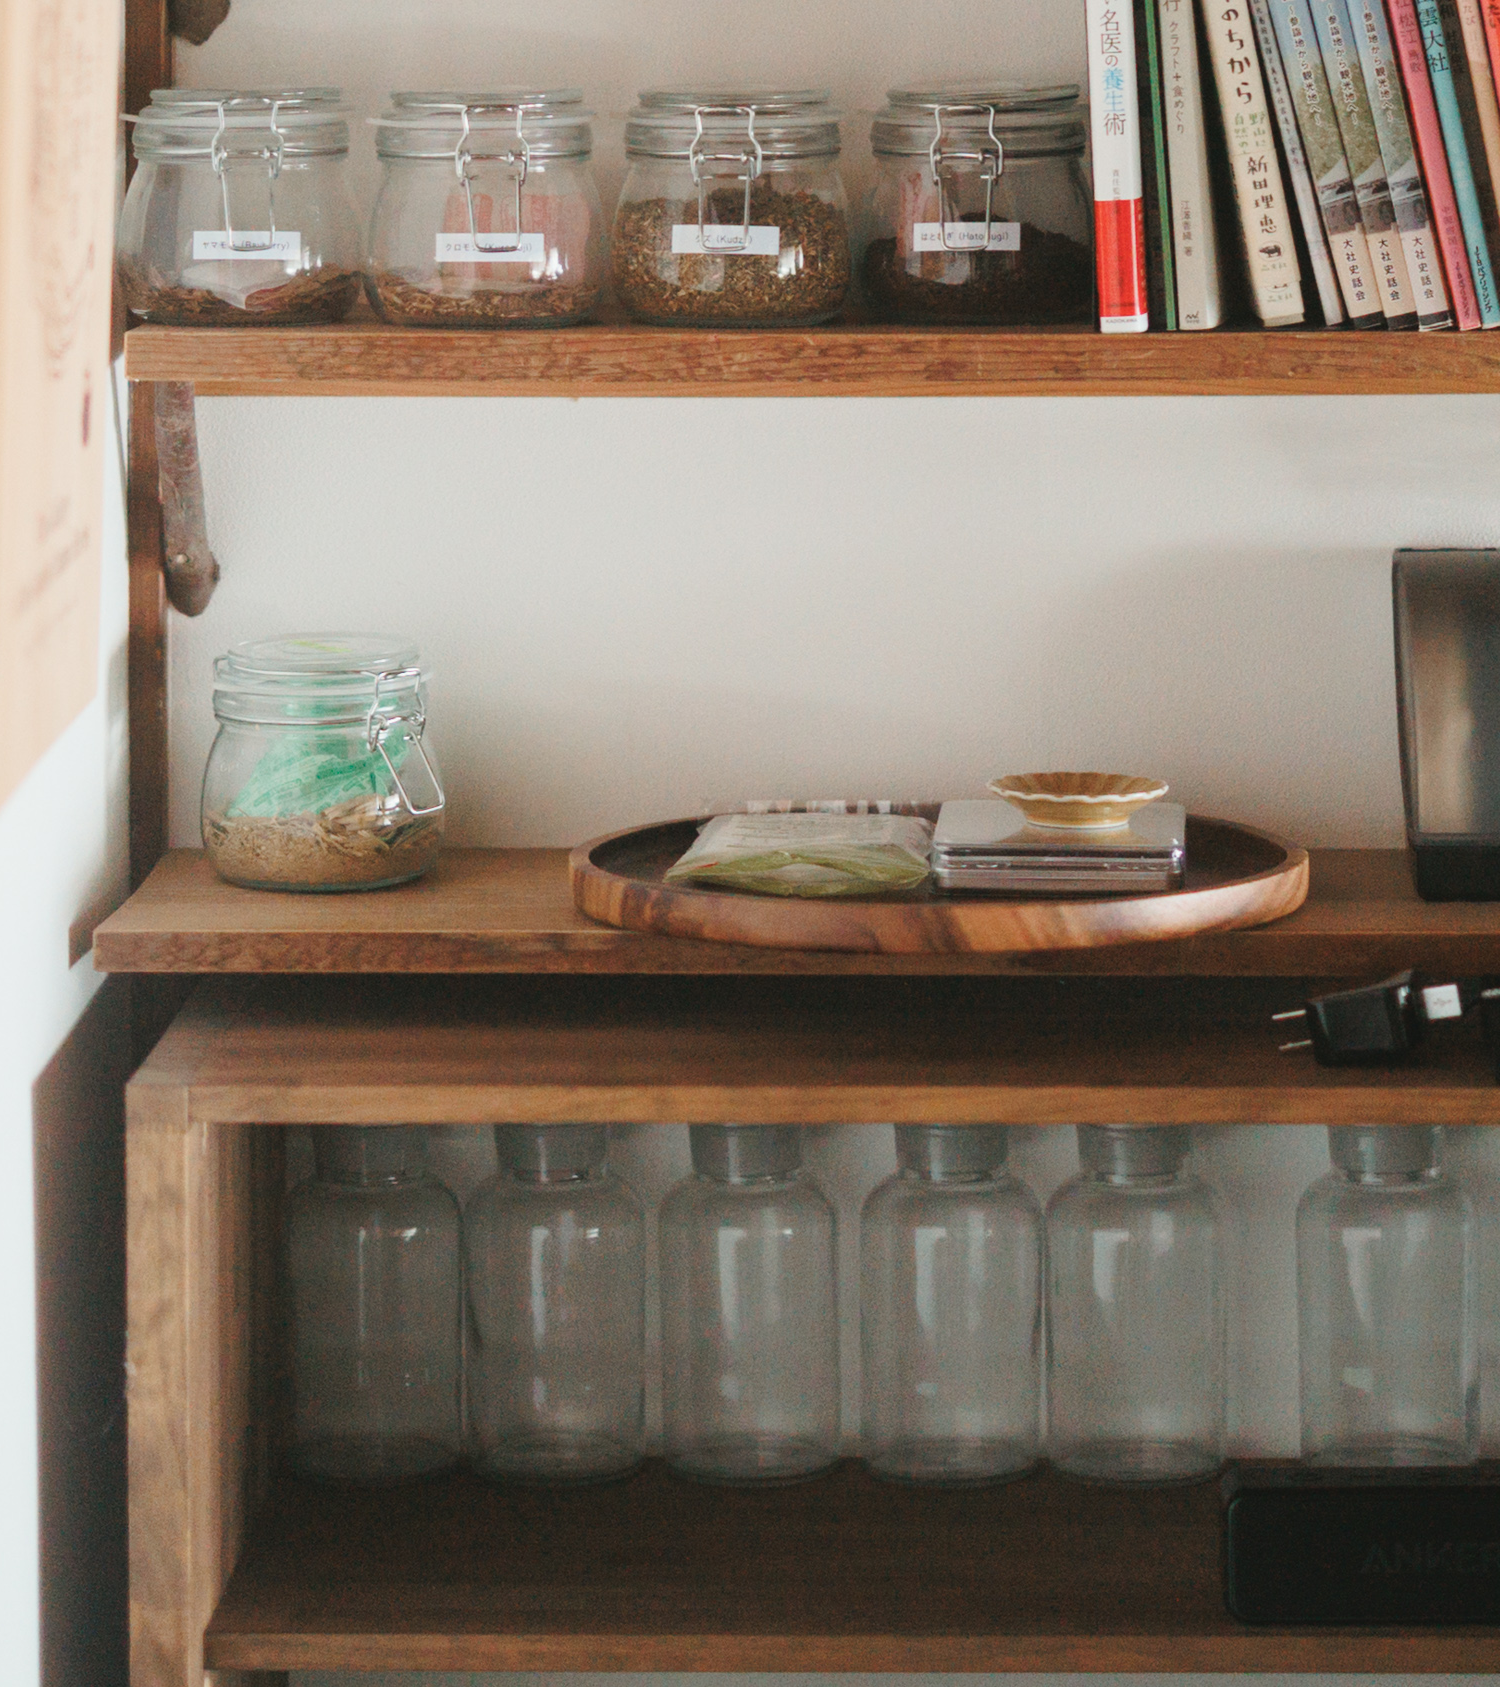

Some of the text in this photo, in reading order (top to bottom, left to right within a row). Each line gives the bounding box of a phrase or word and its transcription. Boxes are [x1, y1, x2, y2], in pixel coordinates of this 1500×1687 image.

[1247, 155, 1277, 234] 新田理恵
[716, 235, 753, 244] (Kudz)
[958, 232, 1009, 242] (Hatougi)
[1412, 236, 1434, 299] 大社史話会
[1342, 236, 1367, 302] 大社史話会
[1378, 237, 1401, 301] 大社史話会
